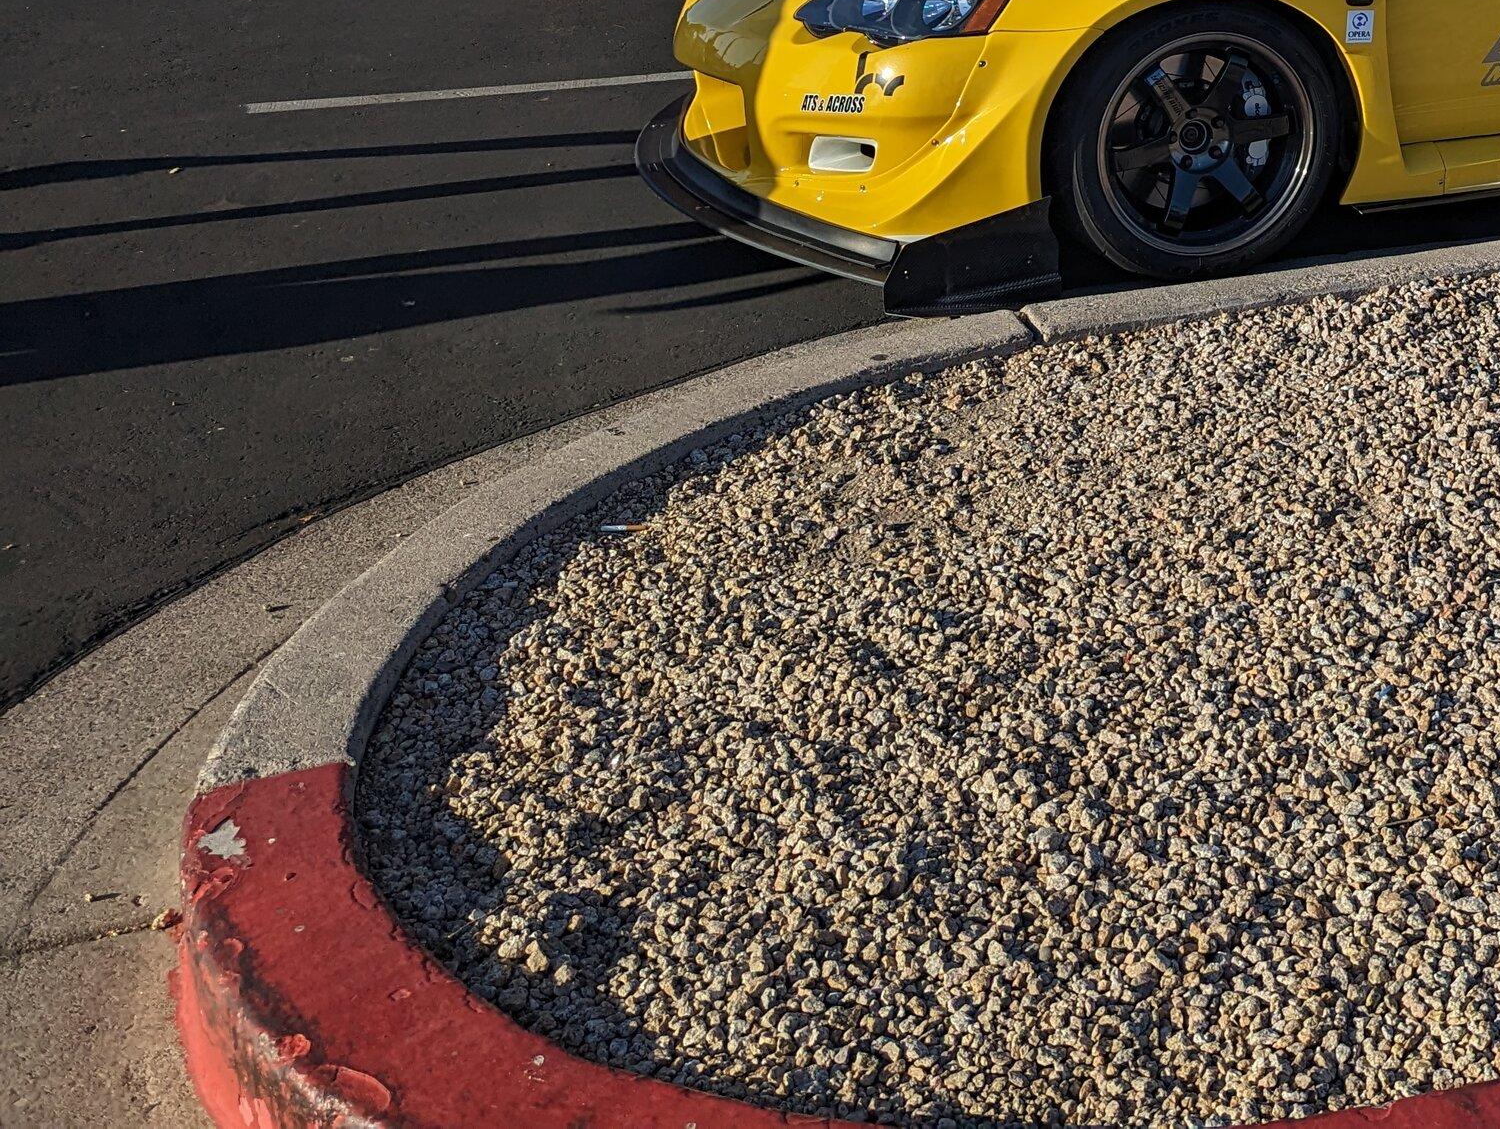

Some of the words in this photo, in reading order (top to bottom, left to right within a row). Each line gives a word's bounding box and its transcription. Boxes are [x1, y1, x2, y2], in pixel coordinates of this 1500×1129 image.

[1348, 30, 1371, 38] OPERA
[801, 94, 819, 112] ATS
[818, 99, 825, 112] &
[825, 95, 866, 114] ACROSS
